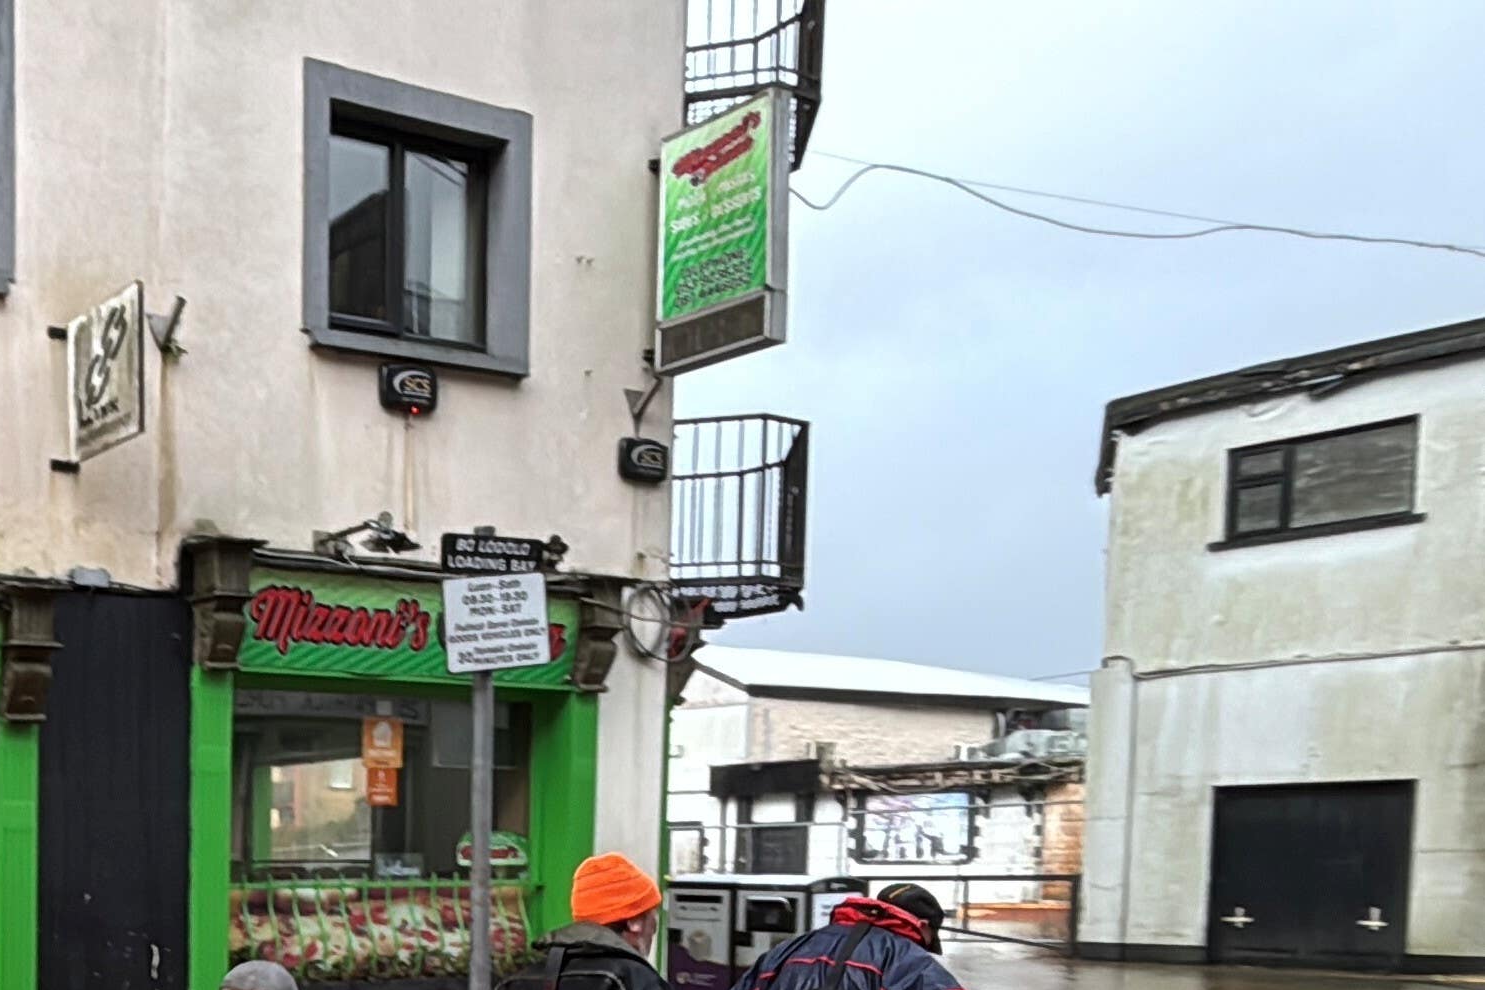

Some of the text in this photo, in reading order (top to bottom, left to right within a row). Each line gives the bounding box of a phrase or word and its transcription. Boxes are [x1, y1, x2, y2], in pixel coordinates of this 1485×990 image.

[447, 555, 536, 571] LOADING BAY
[250, 585, 431, 656] Mizzoni's
